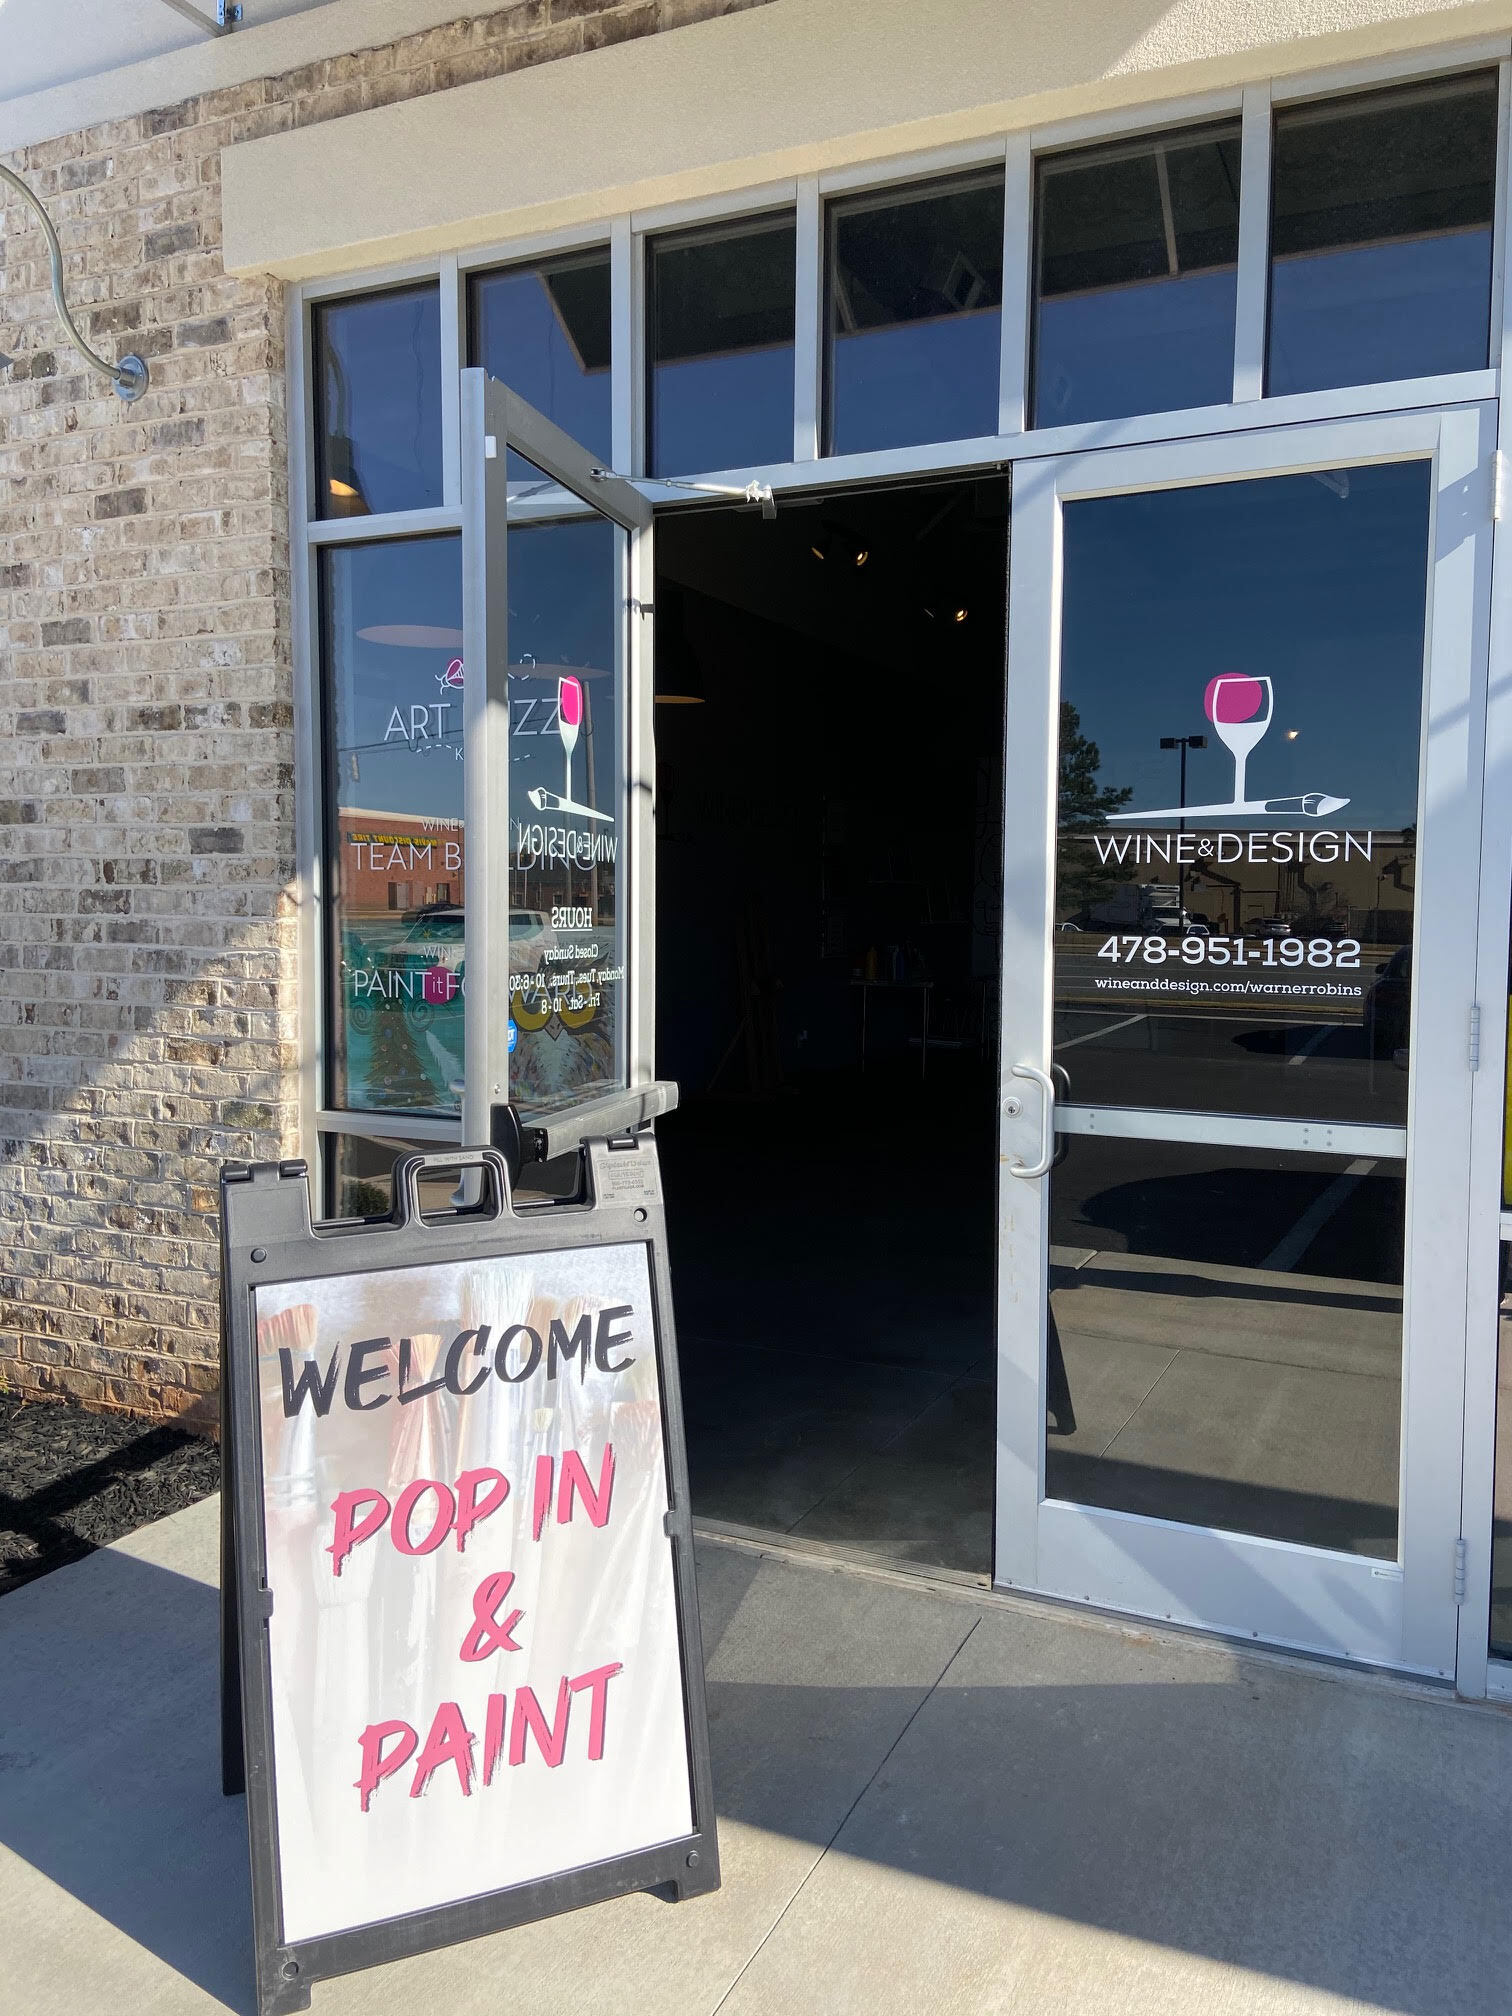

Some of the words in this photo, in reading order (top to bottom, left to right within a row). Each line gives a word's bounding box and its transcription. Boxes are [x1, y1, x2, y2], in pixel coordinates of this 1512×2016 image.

[383, 703, 451, 741] ART
[350, 842, 432, 871] TEAM
[1093, 830, 1374, 864] WINE&DESIGN
[1097, 935, 1361, 968] 478-951-1982
[354, 969, 433, 999] PAINT
[432, 976, 444, 994] it
[1094, 976, 1363, 997] wineanddesign.com/warnerrobins
[279, 1304, 637, 1418] WELCOME
[325, 1467, 511, 1577] POP
[531, 1442, 617, 1542] IN
[459, 1571, 526, 1662] &
[353, 1662, 624, 1813] PAINT
